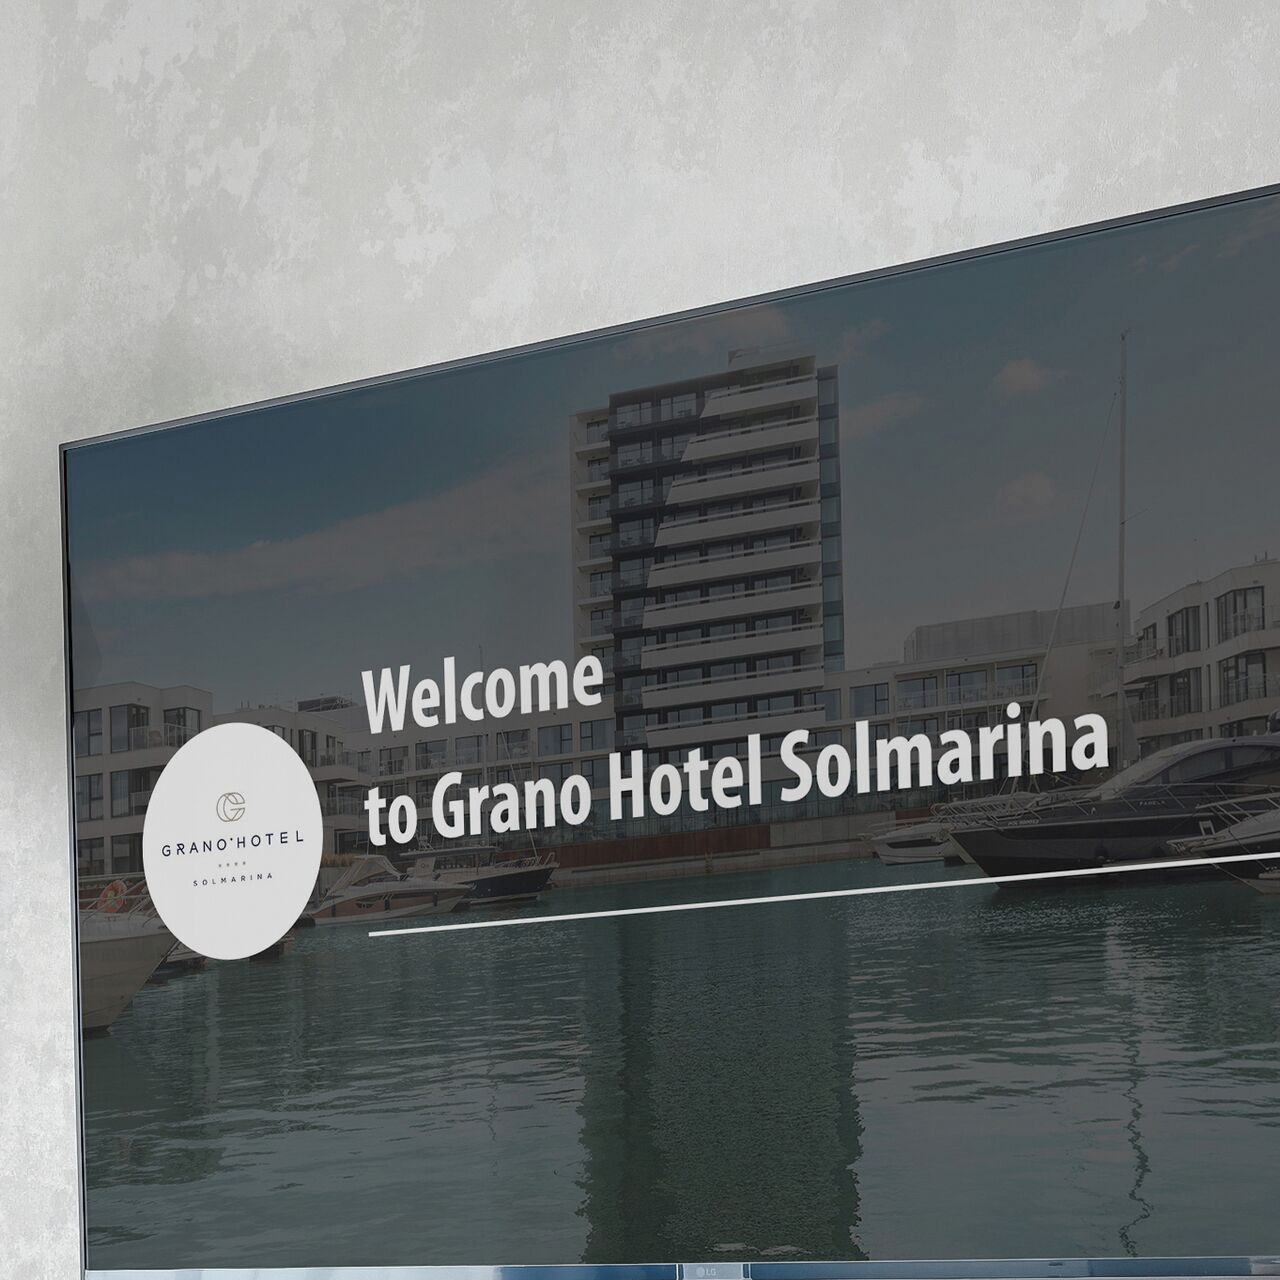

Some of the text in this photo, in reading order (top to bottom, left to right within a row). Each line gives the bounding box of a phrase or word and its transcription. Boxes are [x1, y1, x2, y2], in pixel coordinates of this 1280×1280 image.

[361, 655, 604, 734] Welcome
[364, 702, 1109, 846] to Grano Hotel Solmarina
[192, 872, 273, 887] SOLMARINA
